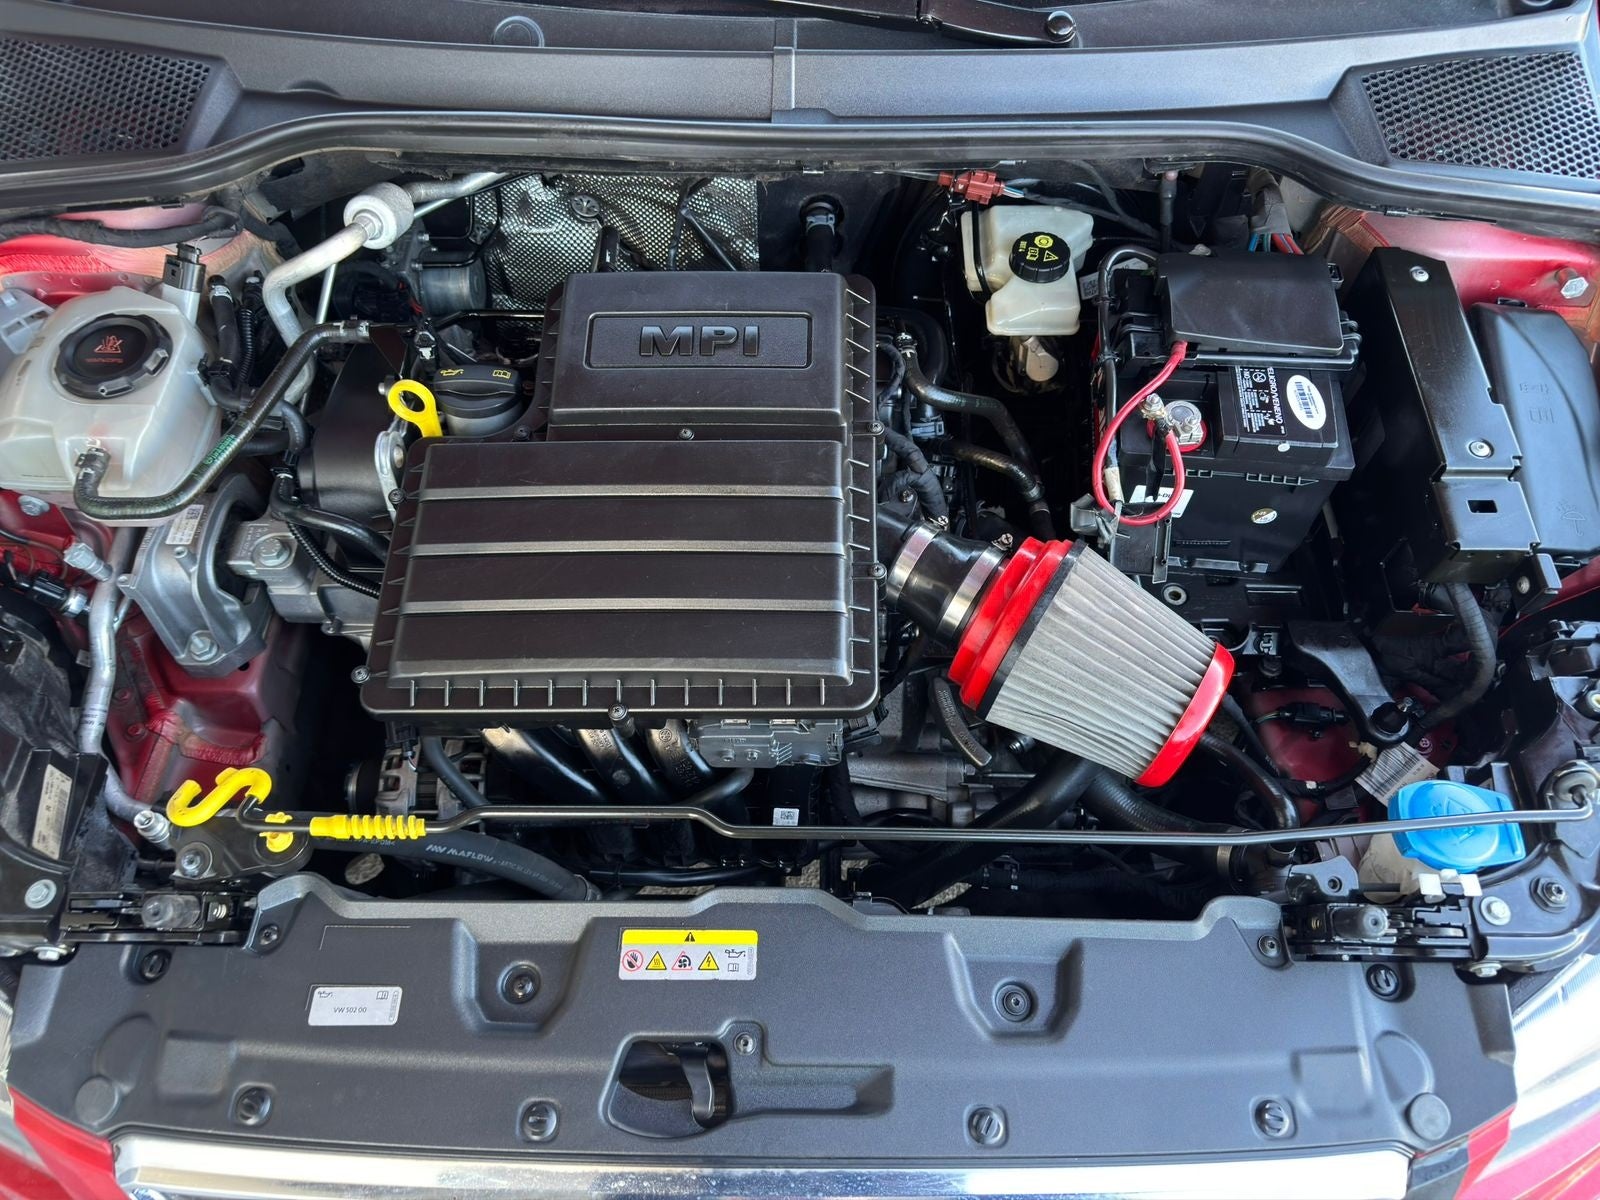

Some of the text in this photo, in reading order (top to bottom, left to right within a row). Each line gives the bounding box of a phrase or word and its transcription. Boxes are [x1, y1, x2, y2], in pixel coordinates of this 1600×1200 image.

[640, 325, 760, 356] MPI
[333, 1006, 368, 1014] VW 502 00
